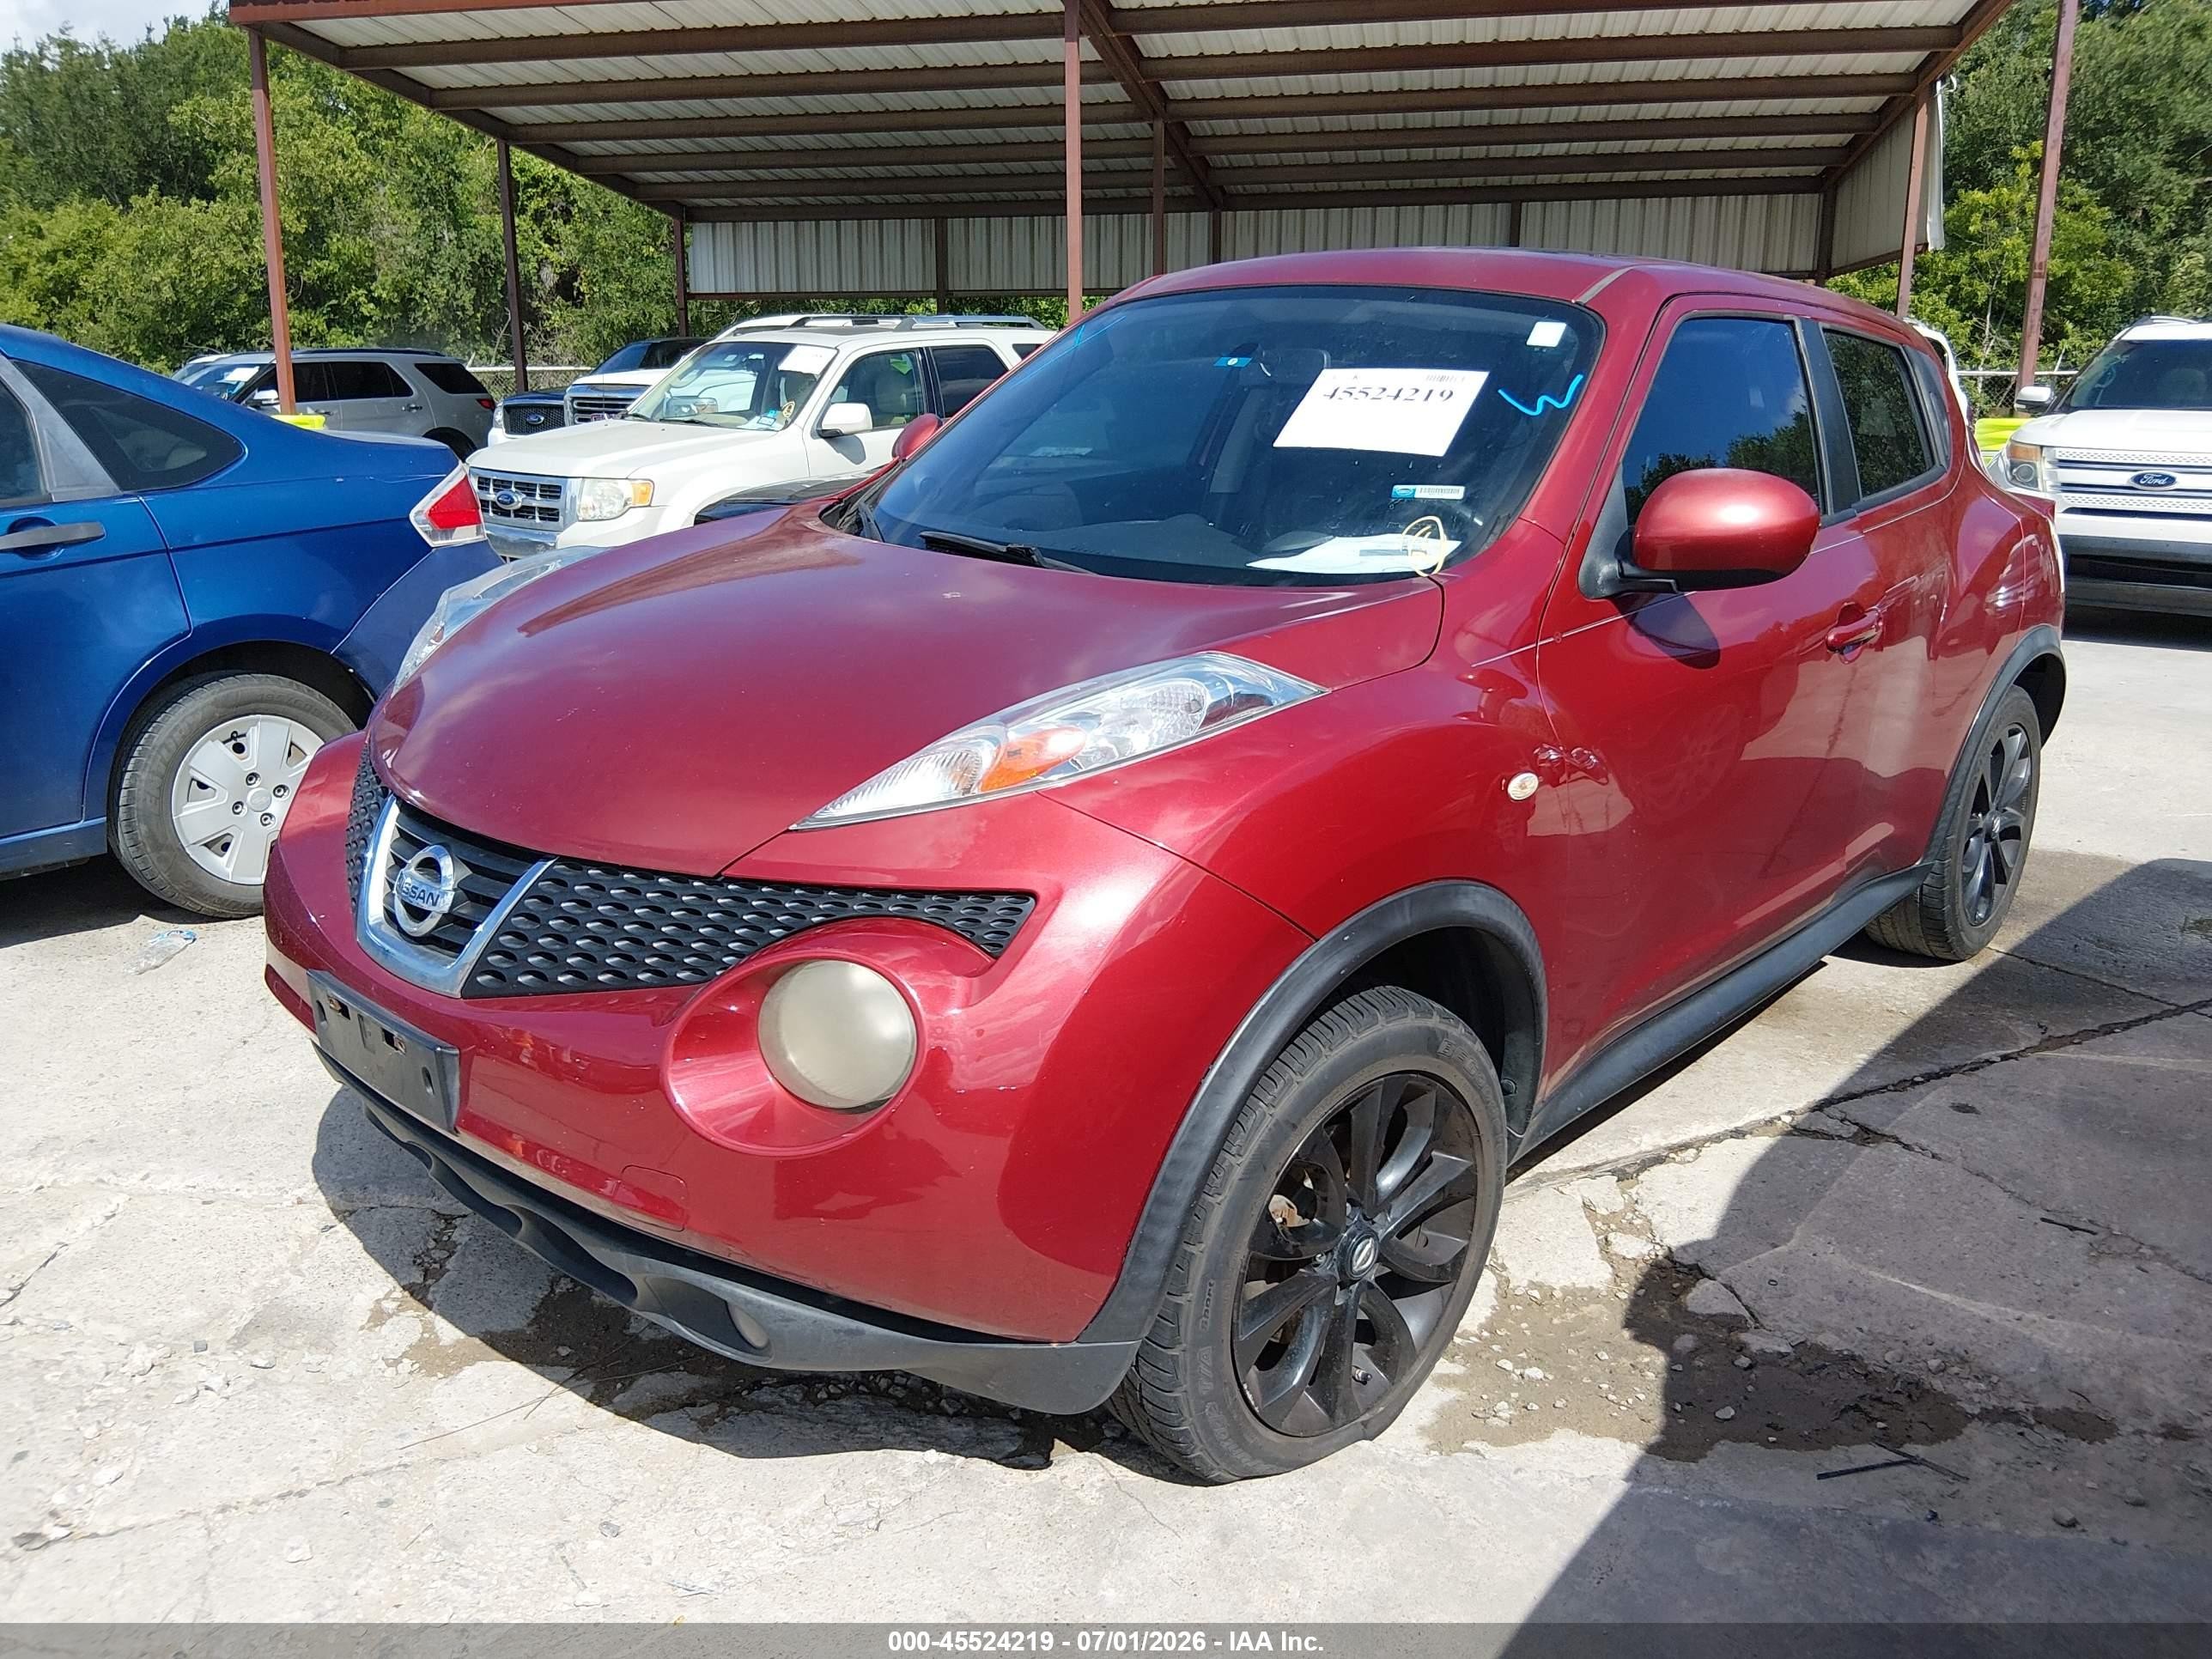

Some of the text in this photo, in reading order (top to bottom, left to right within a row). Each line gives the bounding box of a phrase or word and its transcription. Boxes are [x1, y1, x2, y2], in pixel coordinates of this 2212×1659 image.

[1322, 386, 1455, 403] 45524219
[2139, 473, 2168, 485] Ford
[397, 874, 441, 908] NISSAN
